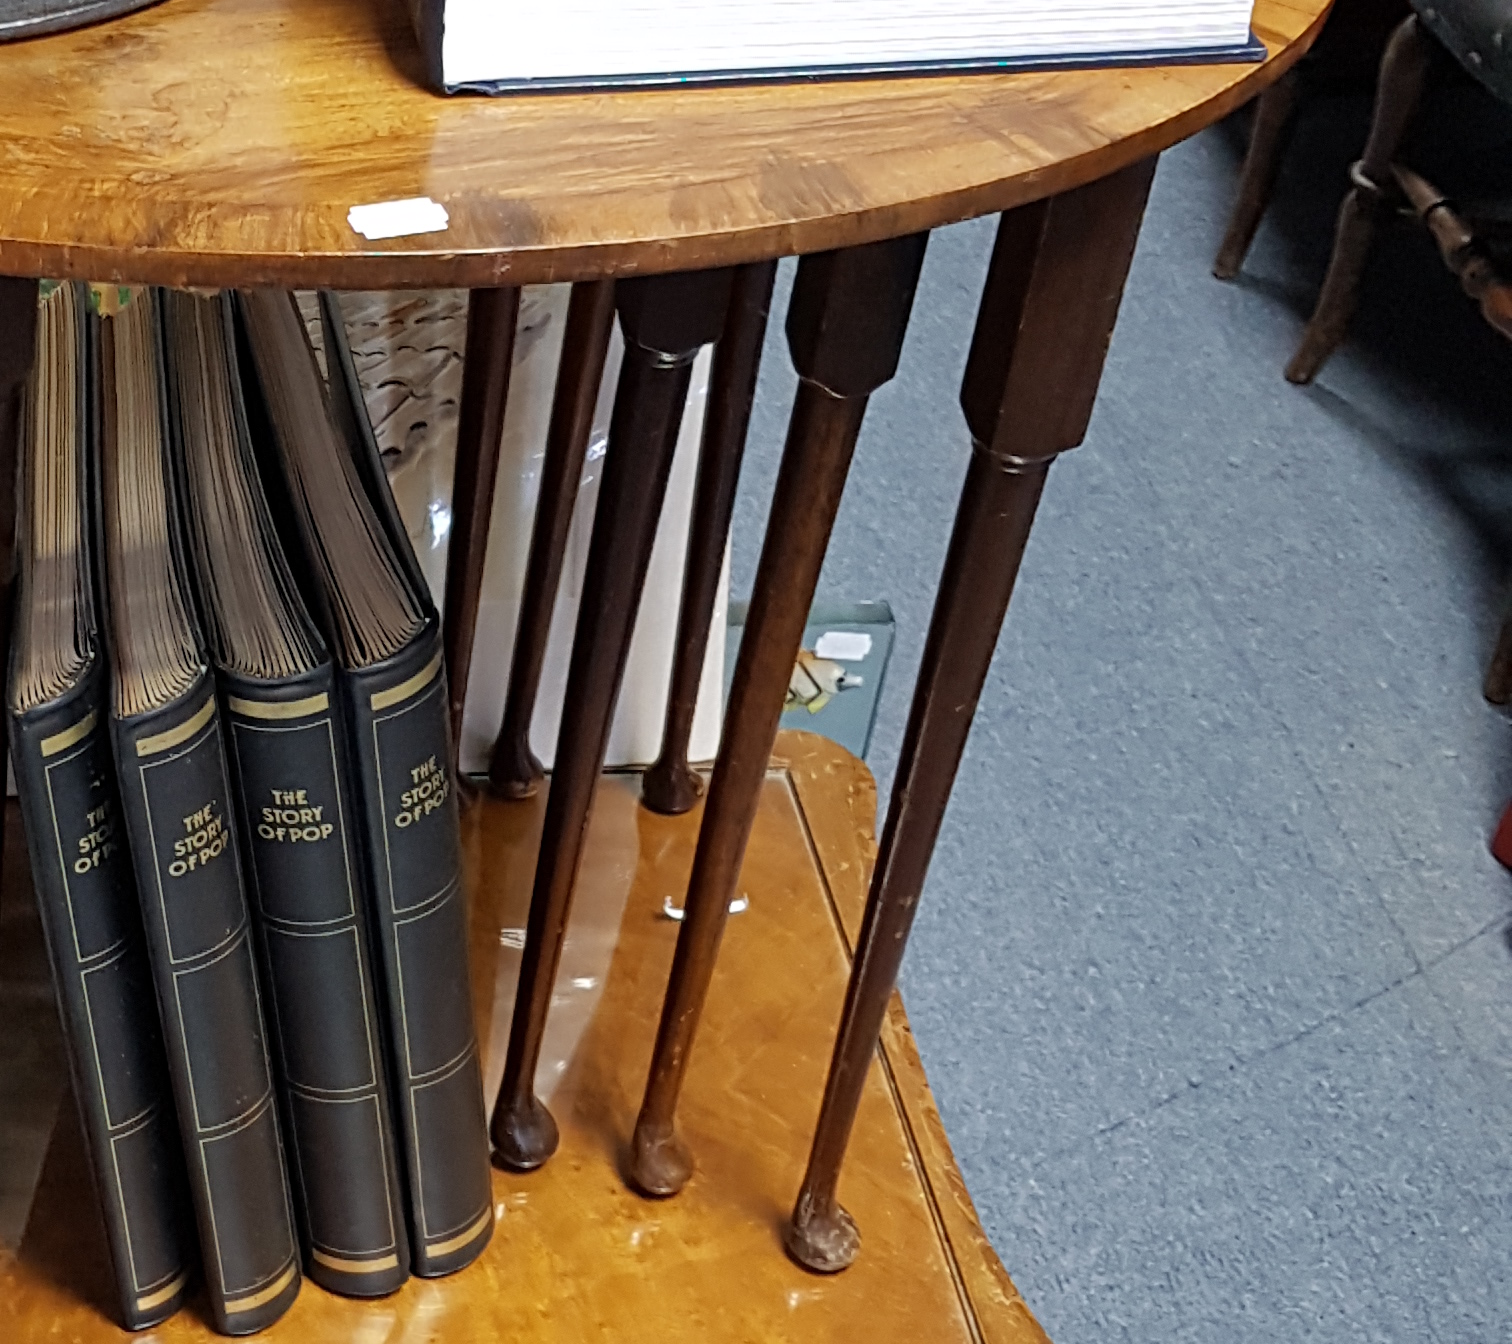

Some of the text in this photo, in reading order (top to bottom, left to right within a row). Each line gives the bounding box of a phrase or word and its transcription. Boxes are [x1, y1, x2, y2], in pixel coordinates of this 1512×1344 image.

[409, 753, 437, 784] THE
[271, 789, 309, 806] THE
[400, 767, 445, 809] STORY
[183, 803, 213, 832] THE
[262, 805, 324, 825] STORY
[394, 779, 450, 829] OF POP
[174, 814, 224, 857] STORY
[257, 822, 334, 843] OF POP
[74, 848, 101, 874] OF
[168, 829, 229, 877] OF POP
